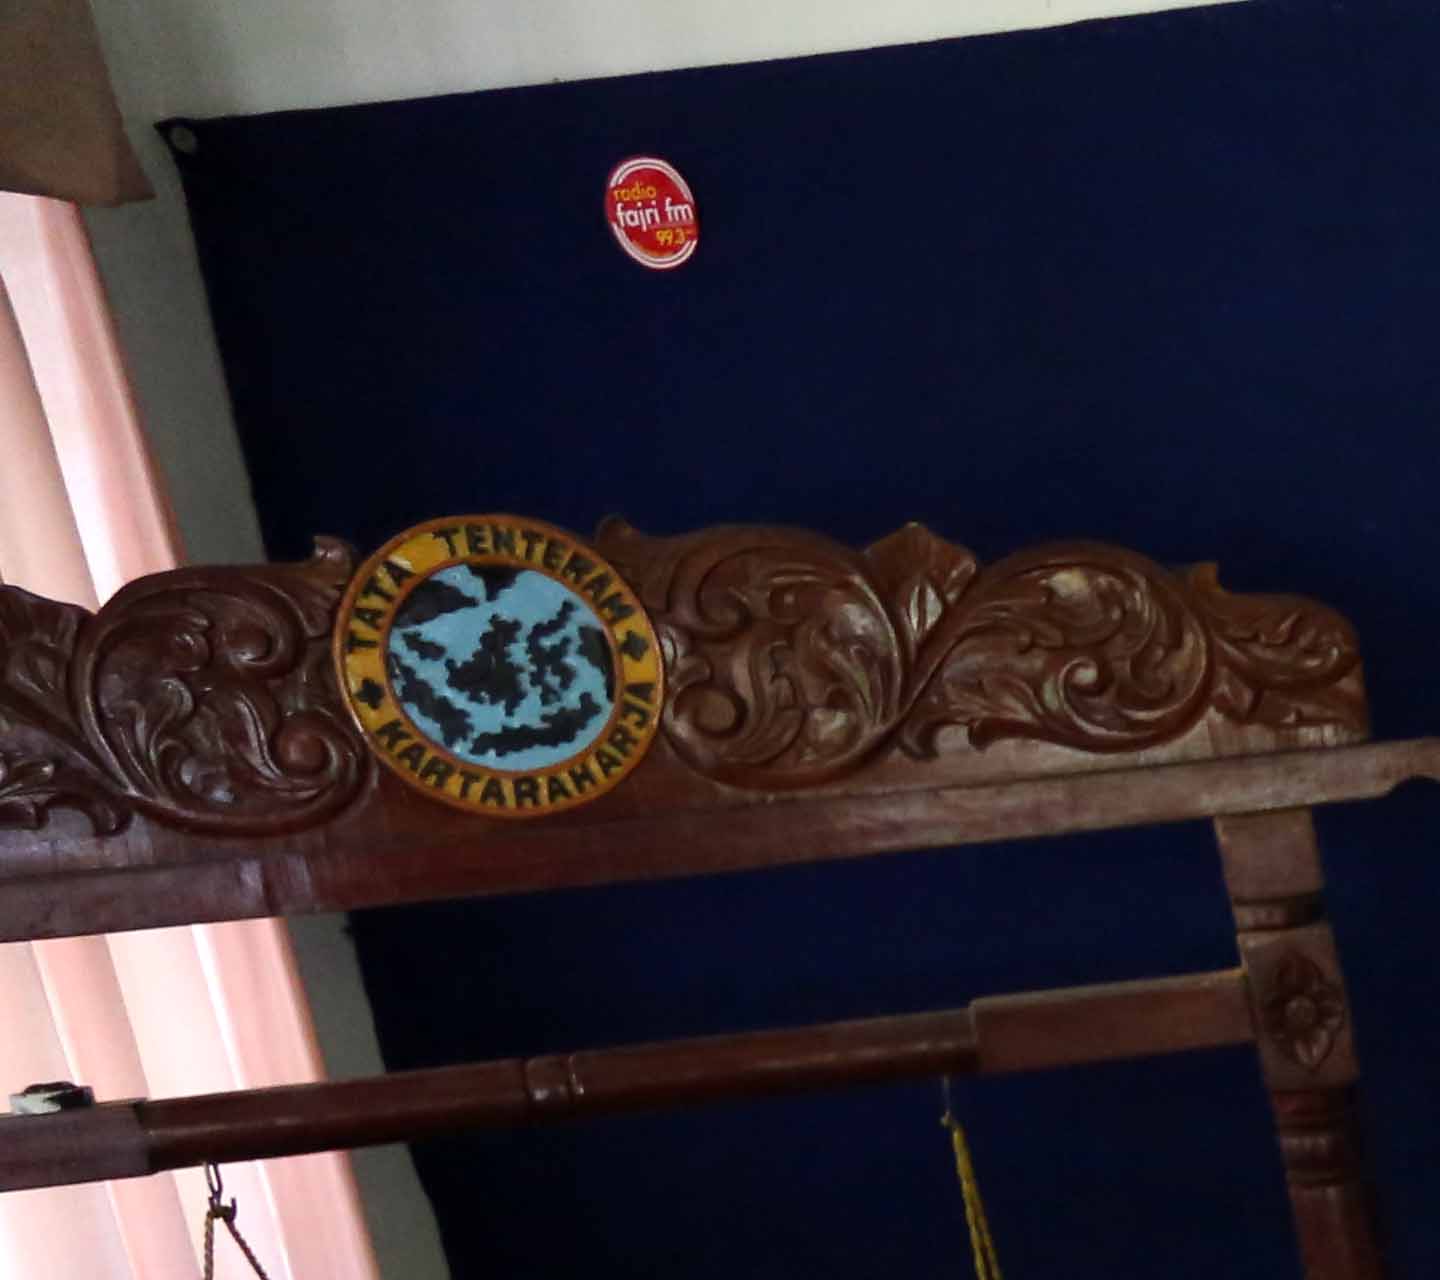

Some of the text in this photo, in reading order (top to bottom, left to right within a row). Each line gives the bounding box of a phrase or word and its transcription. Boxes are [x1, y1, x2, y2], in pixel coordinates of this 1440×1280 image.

[614, 182, 656, 199] radio
[616, 197, 693, 232] fajri fm
[348, 559, 414, 652] TATA
[434, 524, 633, 621] TENTERAM
[376, 682, 653, 807] KARTARAHARJA
